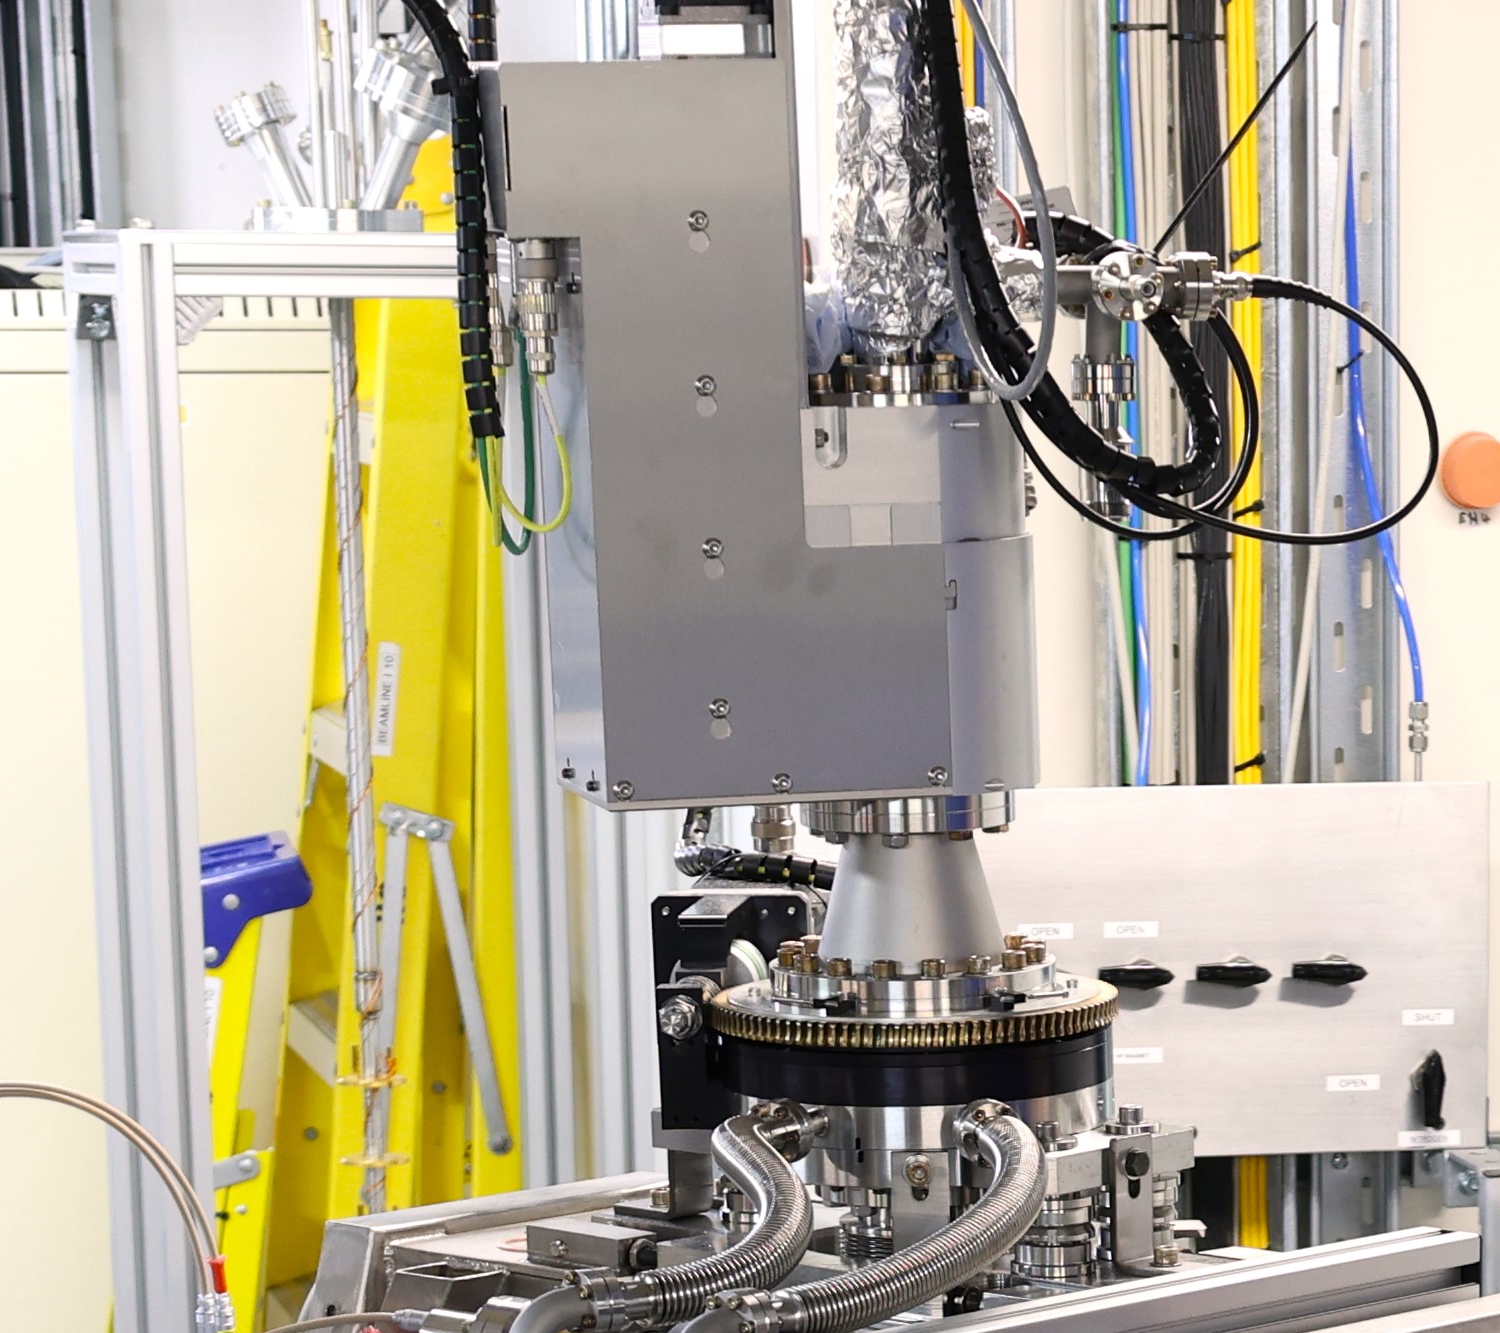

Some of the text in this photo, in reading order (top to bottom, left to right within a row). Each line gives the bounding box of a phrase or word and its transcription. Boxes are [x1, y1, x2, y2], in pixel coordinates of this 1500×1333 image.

[1031, 926, 1061, 937] OPEN
[1116, 925, 1144, 935] OPEN
[1414, 1012, 1442, 1022] SHUT
[1339, 1078, 1367, 1088] OPEN
